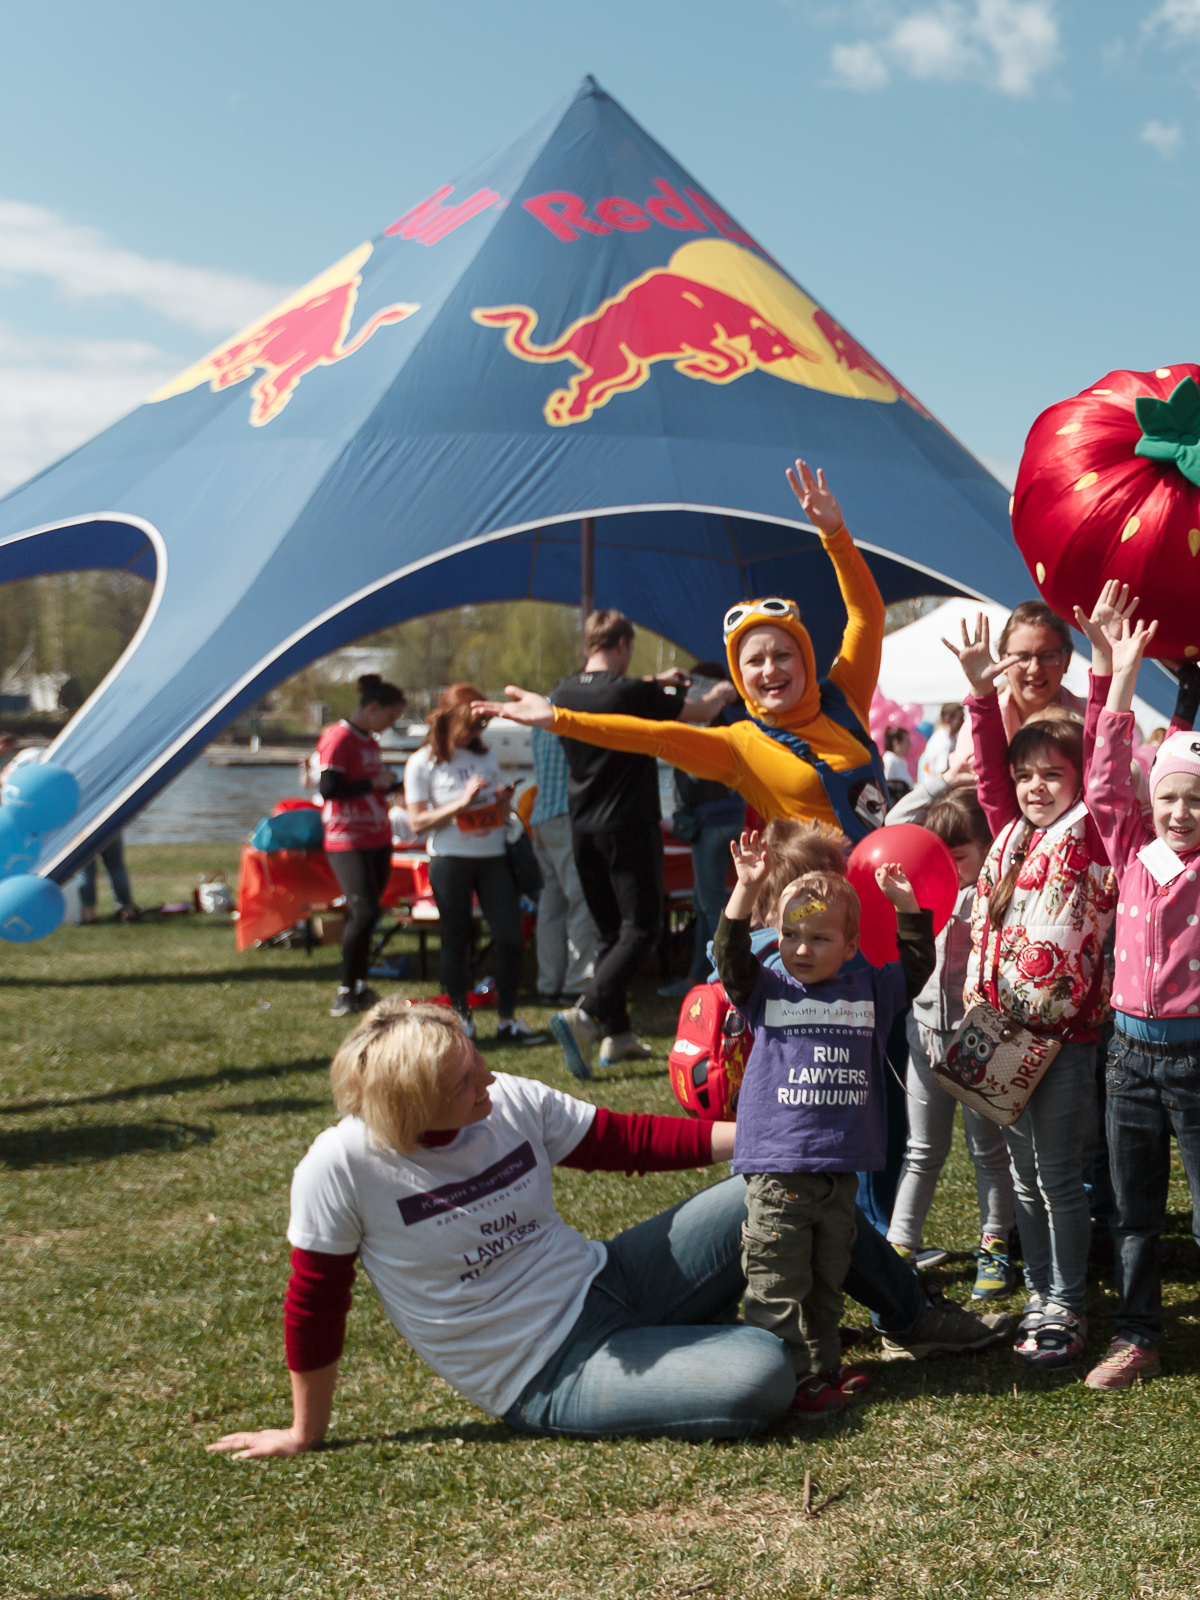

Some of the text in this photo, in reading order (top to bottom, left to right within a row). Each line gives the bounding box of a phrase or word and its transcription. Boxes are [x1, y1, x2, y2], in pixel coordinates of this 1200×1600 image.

[523, 178, 708, 243] Red
[813, 1046, 850, 1063] RUN
[788, 1068, 868, 1087] LAWYERS,
[480, 1211, 517, 1236] RUN
